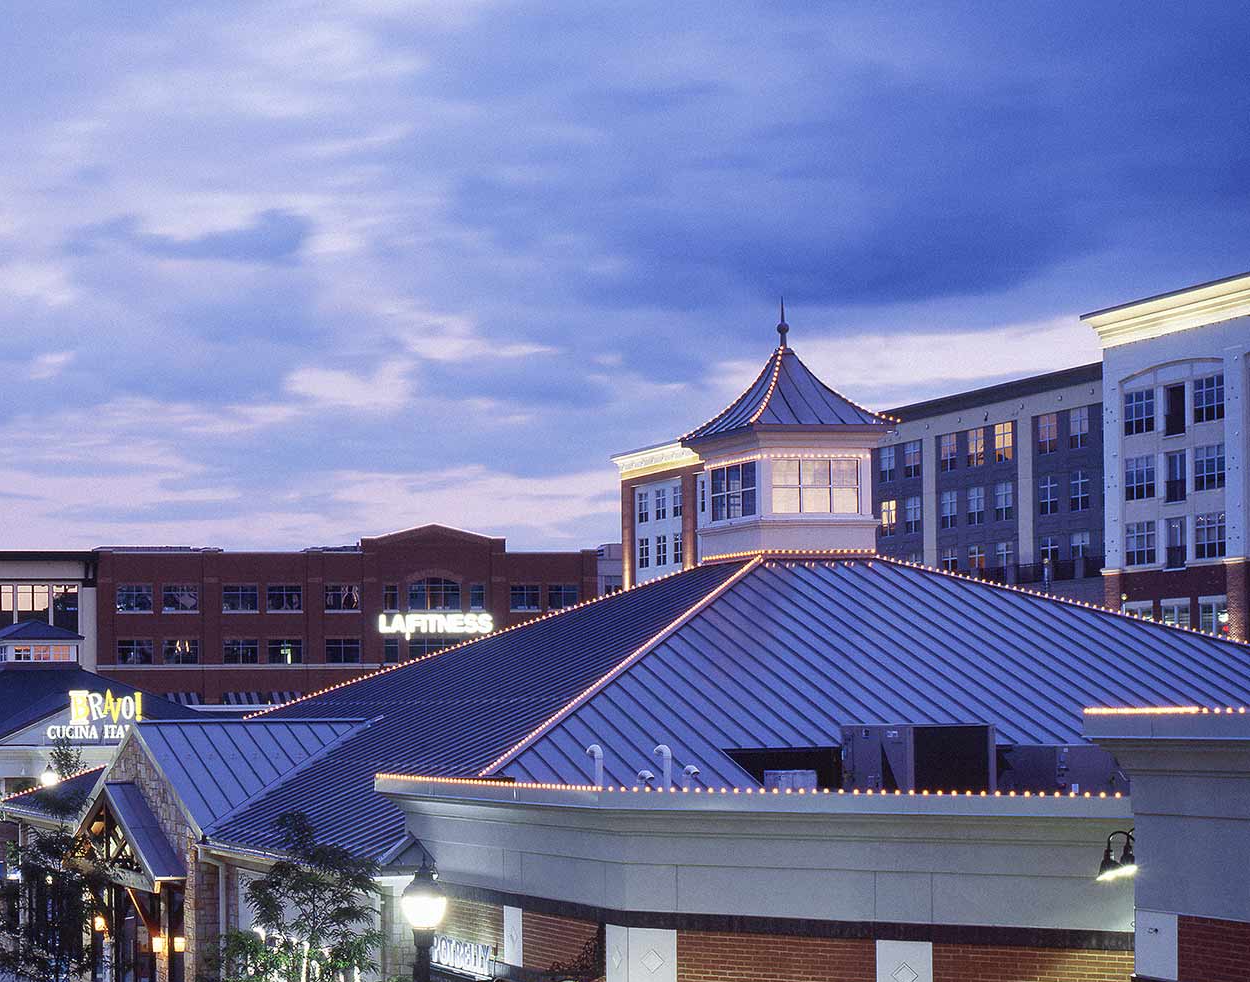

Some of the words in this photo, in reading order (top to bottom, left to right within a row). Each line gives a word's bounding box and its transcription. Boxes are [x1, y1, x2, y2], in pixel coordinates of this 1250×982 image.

[378, 613, 406, 633] LA
[408, 613, 494, 633] FITNESS
[47, 725, 99, 739] CUCINA
[430, 934, 492, 976] POTBELLY
